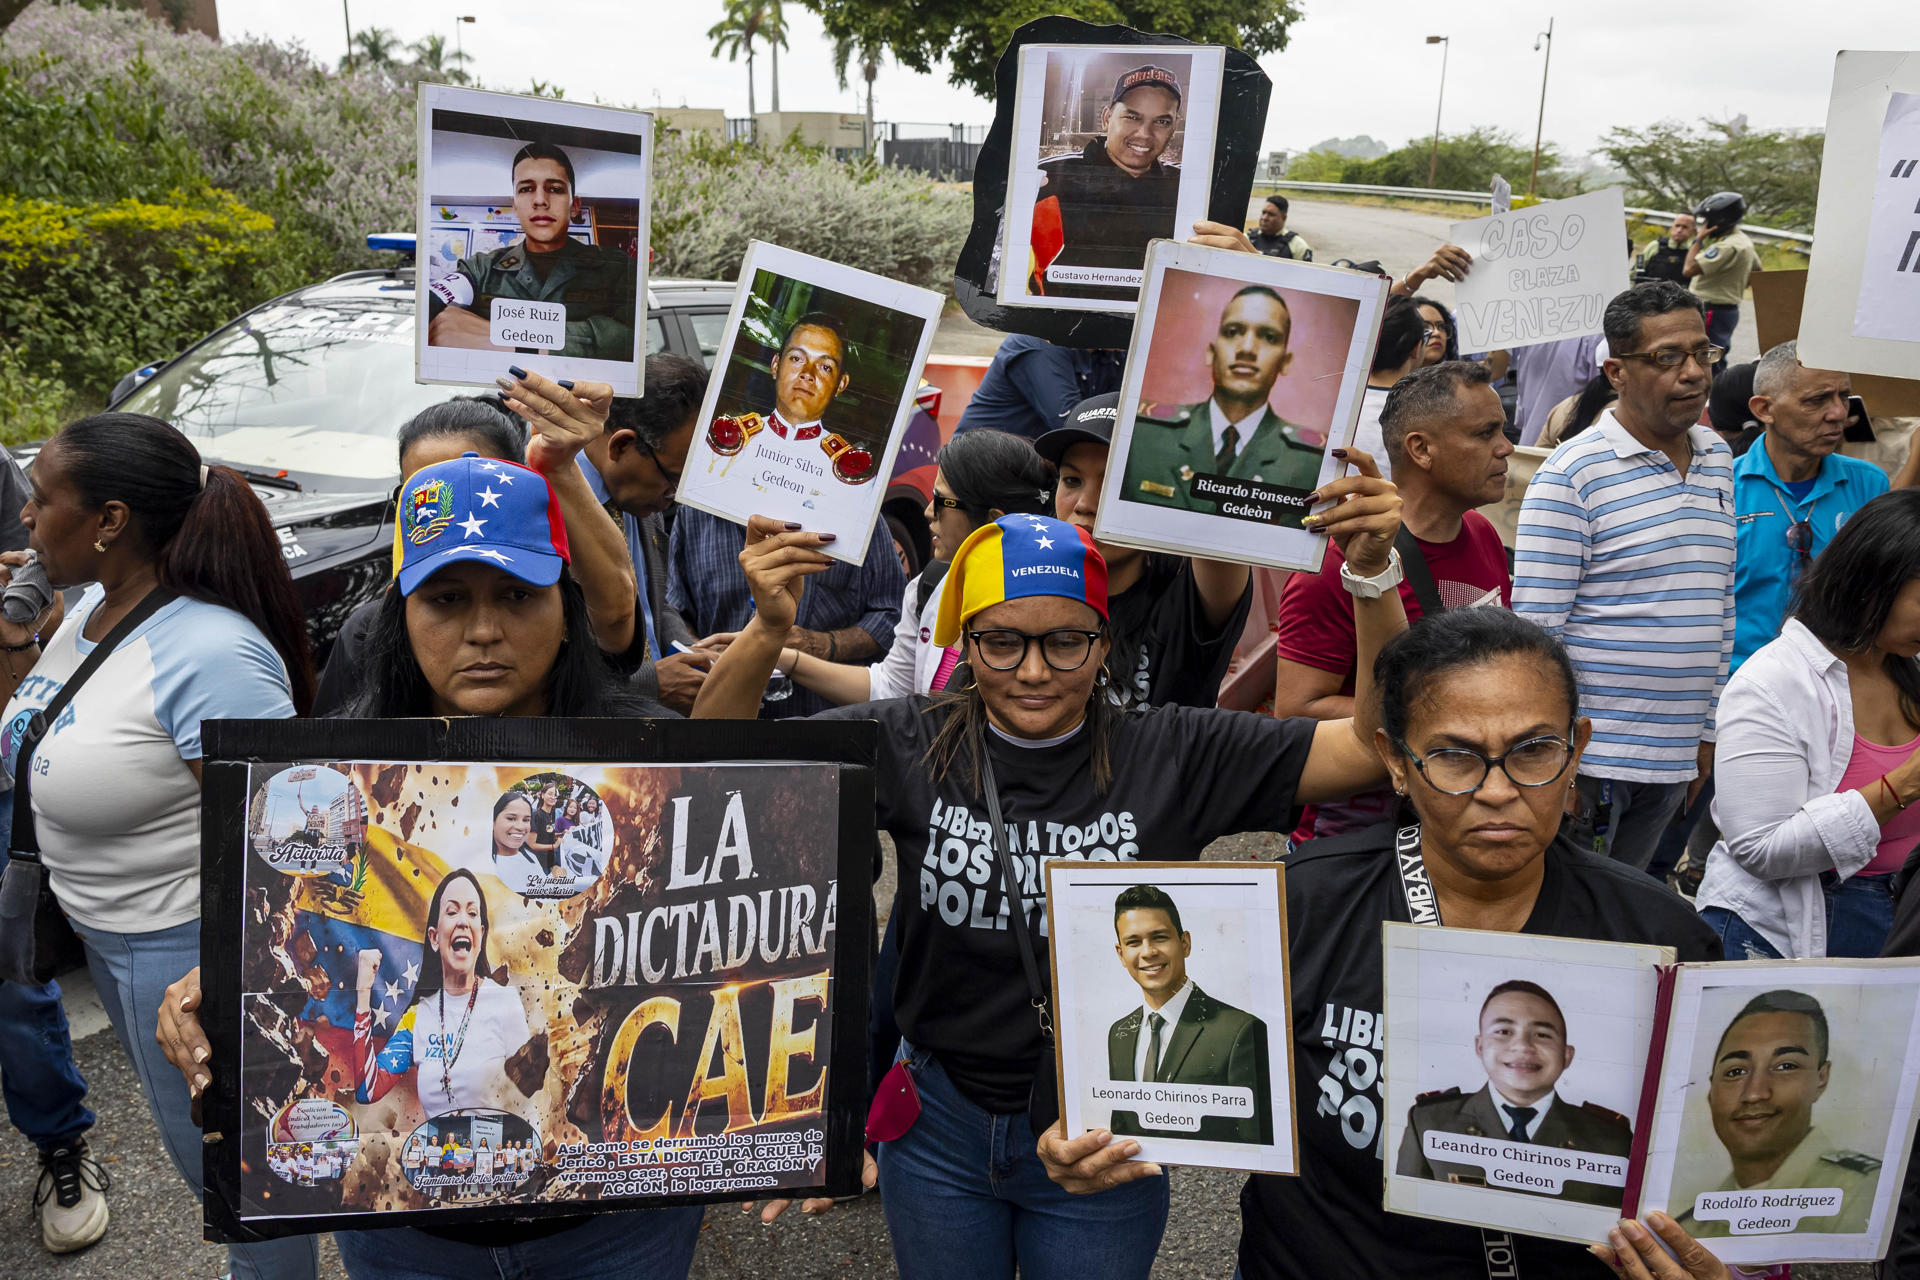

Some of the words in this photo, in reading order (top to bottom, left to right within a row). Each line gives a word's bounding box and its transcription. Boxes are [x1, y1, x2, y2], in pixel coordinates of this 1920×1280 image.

[1480, 214, 1585, 262] CASO
[1052, 270, 1090, 281] Gustavo
[1091, 273, 1142, 284] Hernandez
[1508, 264, 1580, 292] PLAZA
[497, 305, 525, 321] José
[529, 308, 560, 322] Ruiz
[501, 329, 554, 345] Gedeon
[755, 444, 794, 467] Junior
[794, 457, 825, 477] Silva
[762, 470, 805, 495] Gedeon
[1196, 479, 1249, 498] Ricardo
[1222, 502, 1272, 520] Gedeòn
[1011, 565, 1080, 579] VENEZUELA
[665, 790, 759, 891] LA
[1026, 820, 1040, 852] A
[1046, 812, 1138, 854] TODOS
[269, 843, 344, 865] Activista
[923, 828, 994, 885] LOS
[527, 874, 542, 888] La
[588, 880, 838, 991] DICTADURA
[602, 969, 831, 1142] CAE
[1092, 1087, 1151, 1101] Leonardo
[1155, 1090, 1208, 1104] Chirinos
[1212, 1093, 1246, 1107] Parra
[1145, 1112, 1194, 1126] Gedeon
[557, 1143, 582, 1155] Así
[586, 1141, 628, 1154] como
[632, 1140, 650, 1150] se
[654, 1134, 727, 1150] derrumbó
[729, 1133, 752, 1145] los
[755, 1132, 801, 1145] muros
[804, 1129, 823, 1142] de
[556, 1156, 606, 1168] Jericó
[618, 1150, 659, 1167] ESTÁ
[662, 1146, 752, 1164] DICTADURA
[756, 1145, 806, 1158] CRUEL
[808, 1143, 823, 1155] la
[1431, 1136, 1498, 1158] Leandro
[1502, 1147, 1571, 1169] Chirinos
[1576, 1157, 1623, 1177] Parra
[560, 1170, 628, 1182] veremos
[629, 1167, 668, 1180] caer,
[670, 1166, 700, 1177] con
[702, 1161, 723, 1176] FÉ
[734, 1155, 804, 1174] ORACIÓN
[807, 1157, 820, 1173] Y
[1493, 1168, 1555, 1189] Gedeon
[414, 1174, 464, 1189] Familiares
[466, 1174, 478, 1184] de
[479, 1172, 491, 1183] los
[602, 1179, 669, 1196] ACCIÓN,
[671, 1179, 687, 1192] lo
[689, 1175, 778, 1193] lograremos.
[1701, 1195, 1757, 1210] Rodolfo
[1761, 1194, 1836, 1209] Rodríguez
[1737, 1217, 1791, 1230] Gedeon
